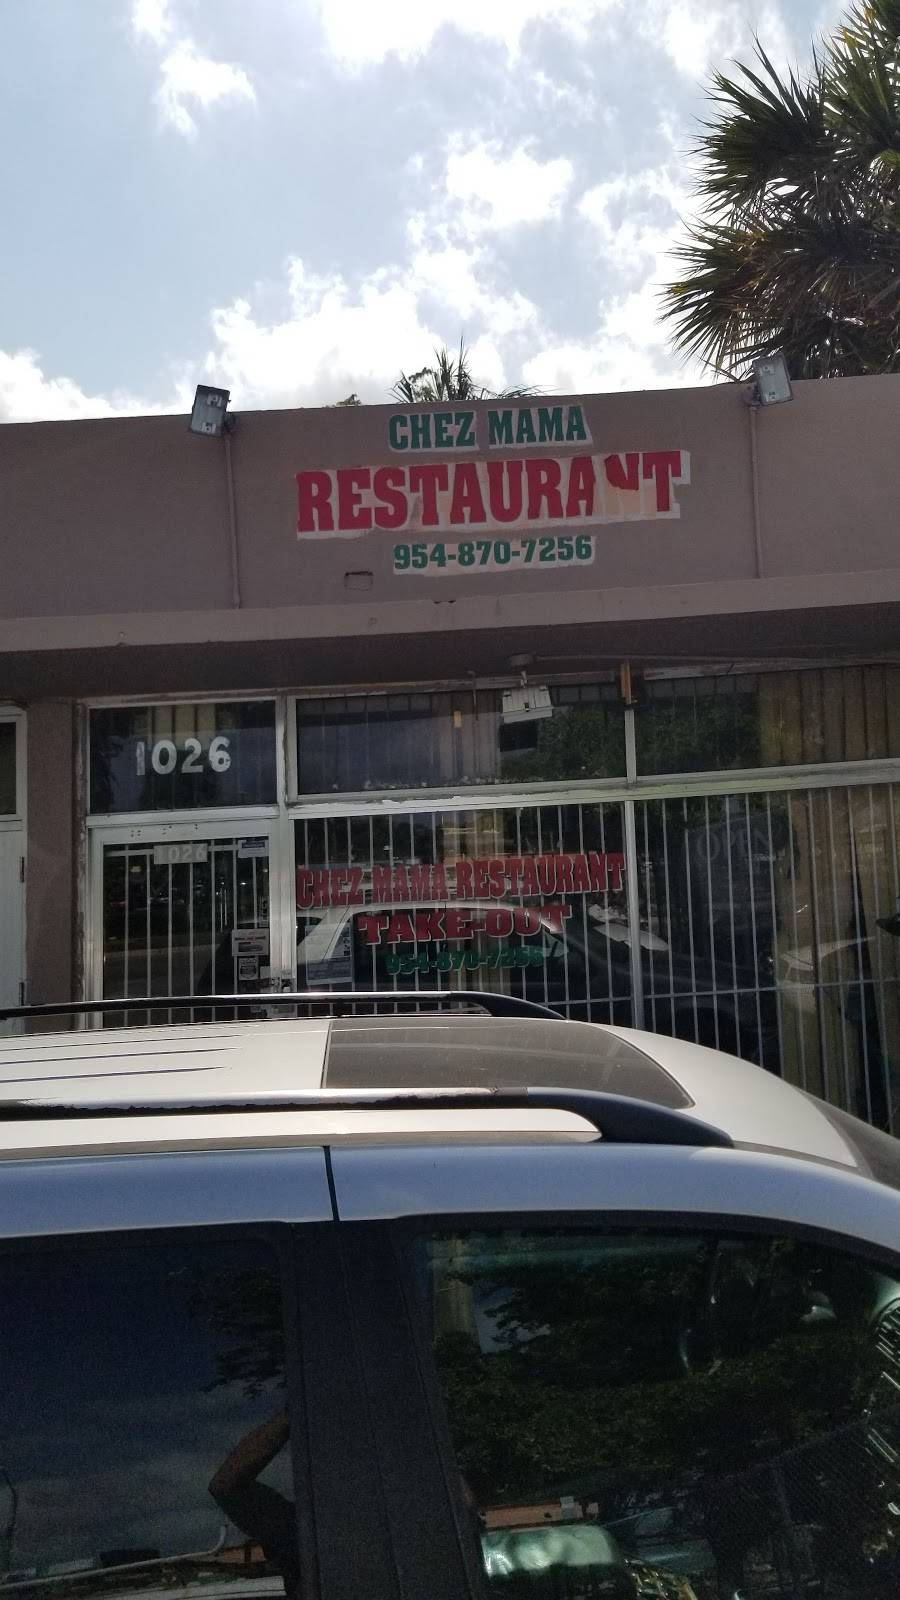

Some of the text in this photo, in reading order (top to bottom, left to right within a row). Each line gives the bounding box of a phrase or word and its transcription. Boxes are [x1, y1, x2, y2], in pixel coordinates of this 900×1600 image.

[389, 405, 588, 450] CHEZ MAMA
[394, 535, 592, 570] 954-870-7256
[136, 736, 231, 775] 1026
[157, 845, 206, 863] 1026
[297, 851, 625, 909] CHEZ MAMA RESTAURANT
[357, 905, 573, 946] TAKE-OUT
